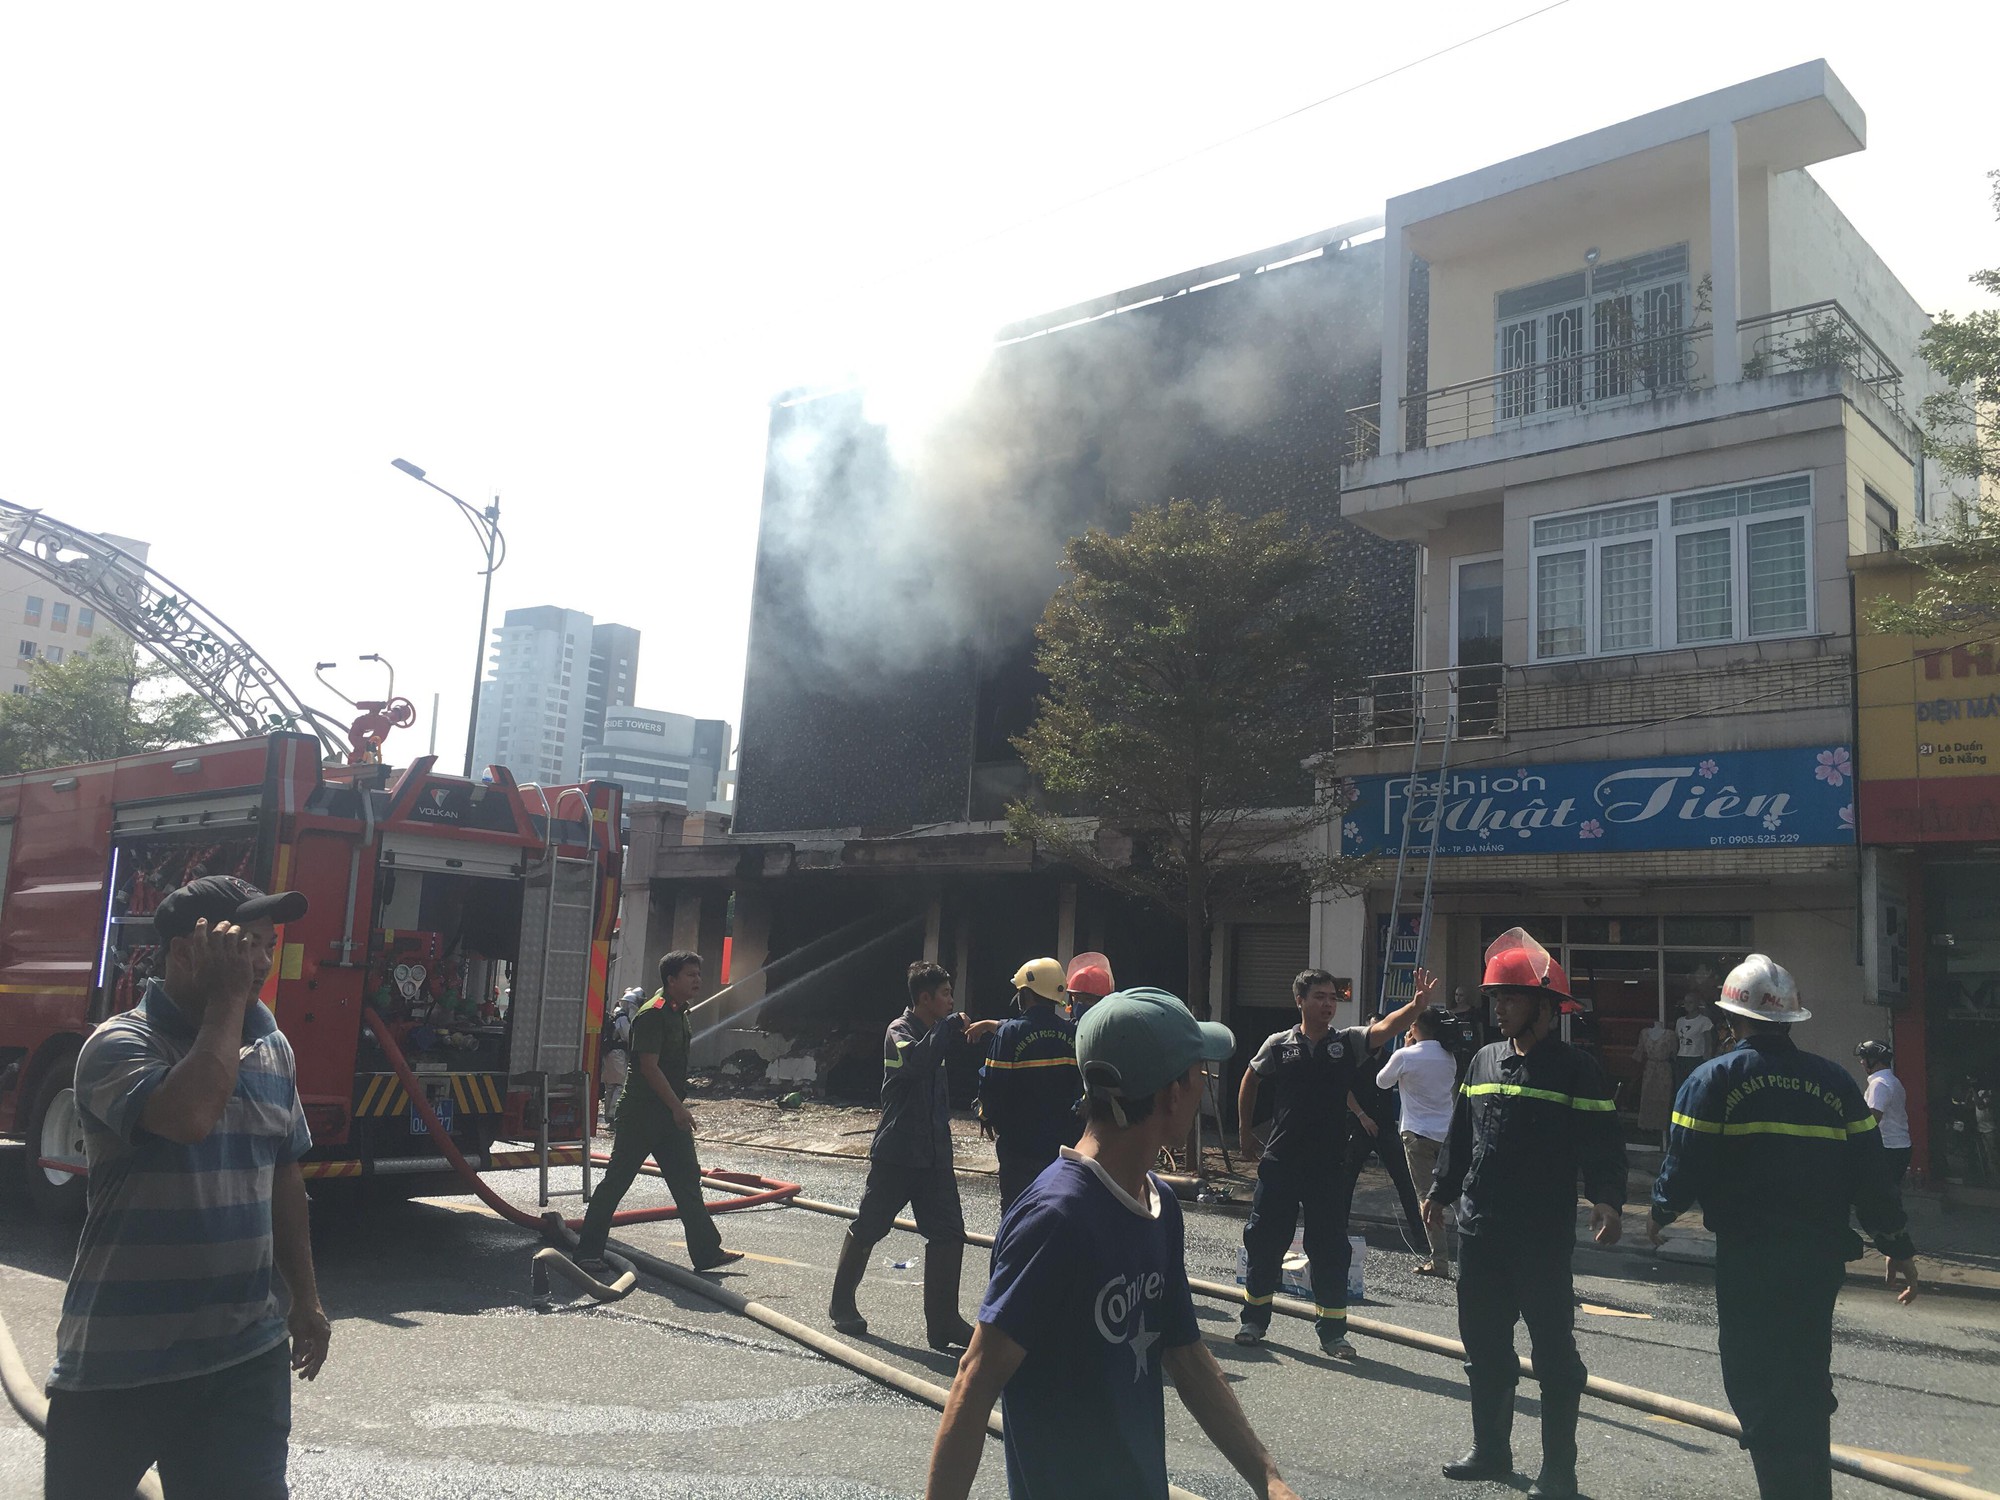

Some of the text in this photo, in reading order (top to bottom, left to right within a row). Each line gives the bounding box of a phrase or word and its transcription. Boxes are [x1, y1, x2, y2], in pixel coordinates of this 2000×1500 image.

[625, 720, 661, 732] TOWERS
[1919, 744, 1933, 754] 21
[1593, 766, 1799, 824] Tiên
[418, 807, 458, 818] VOLKAN
[1728, 833, 1801, 845] 0905.525.229
[1767, 1074, 1800, 1090] PCCC
